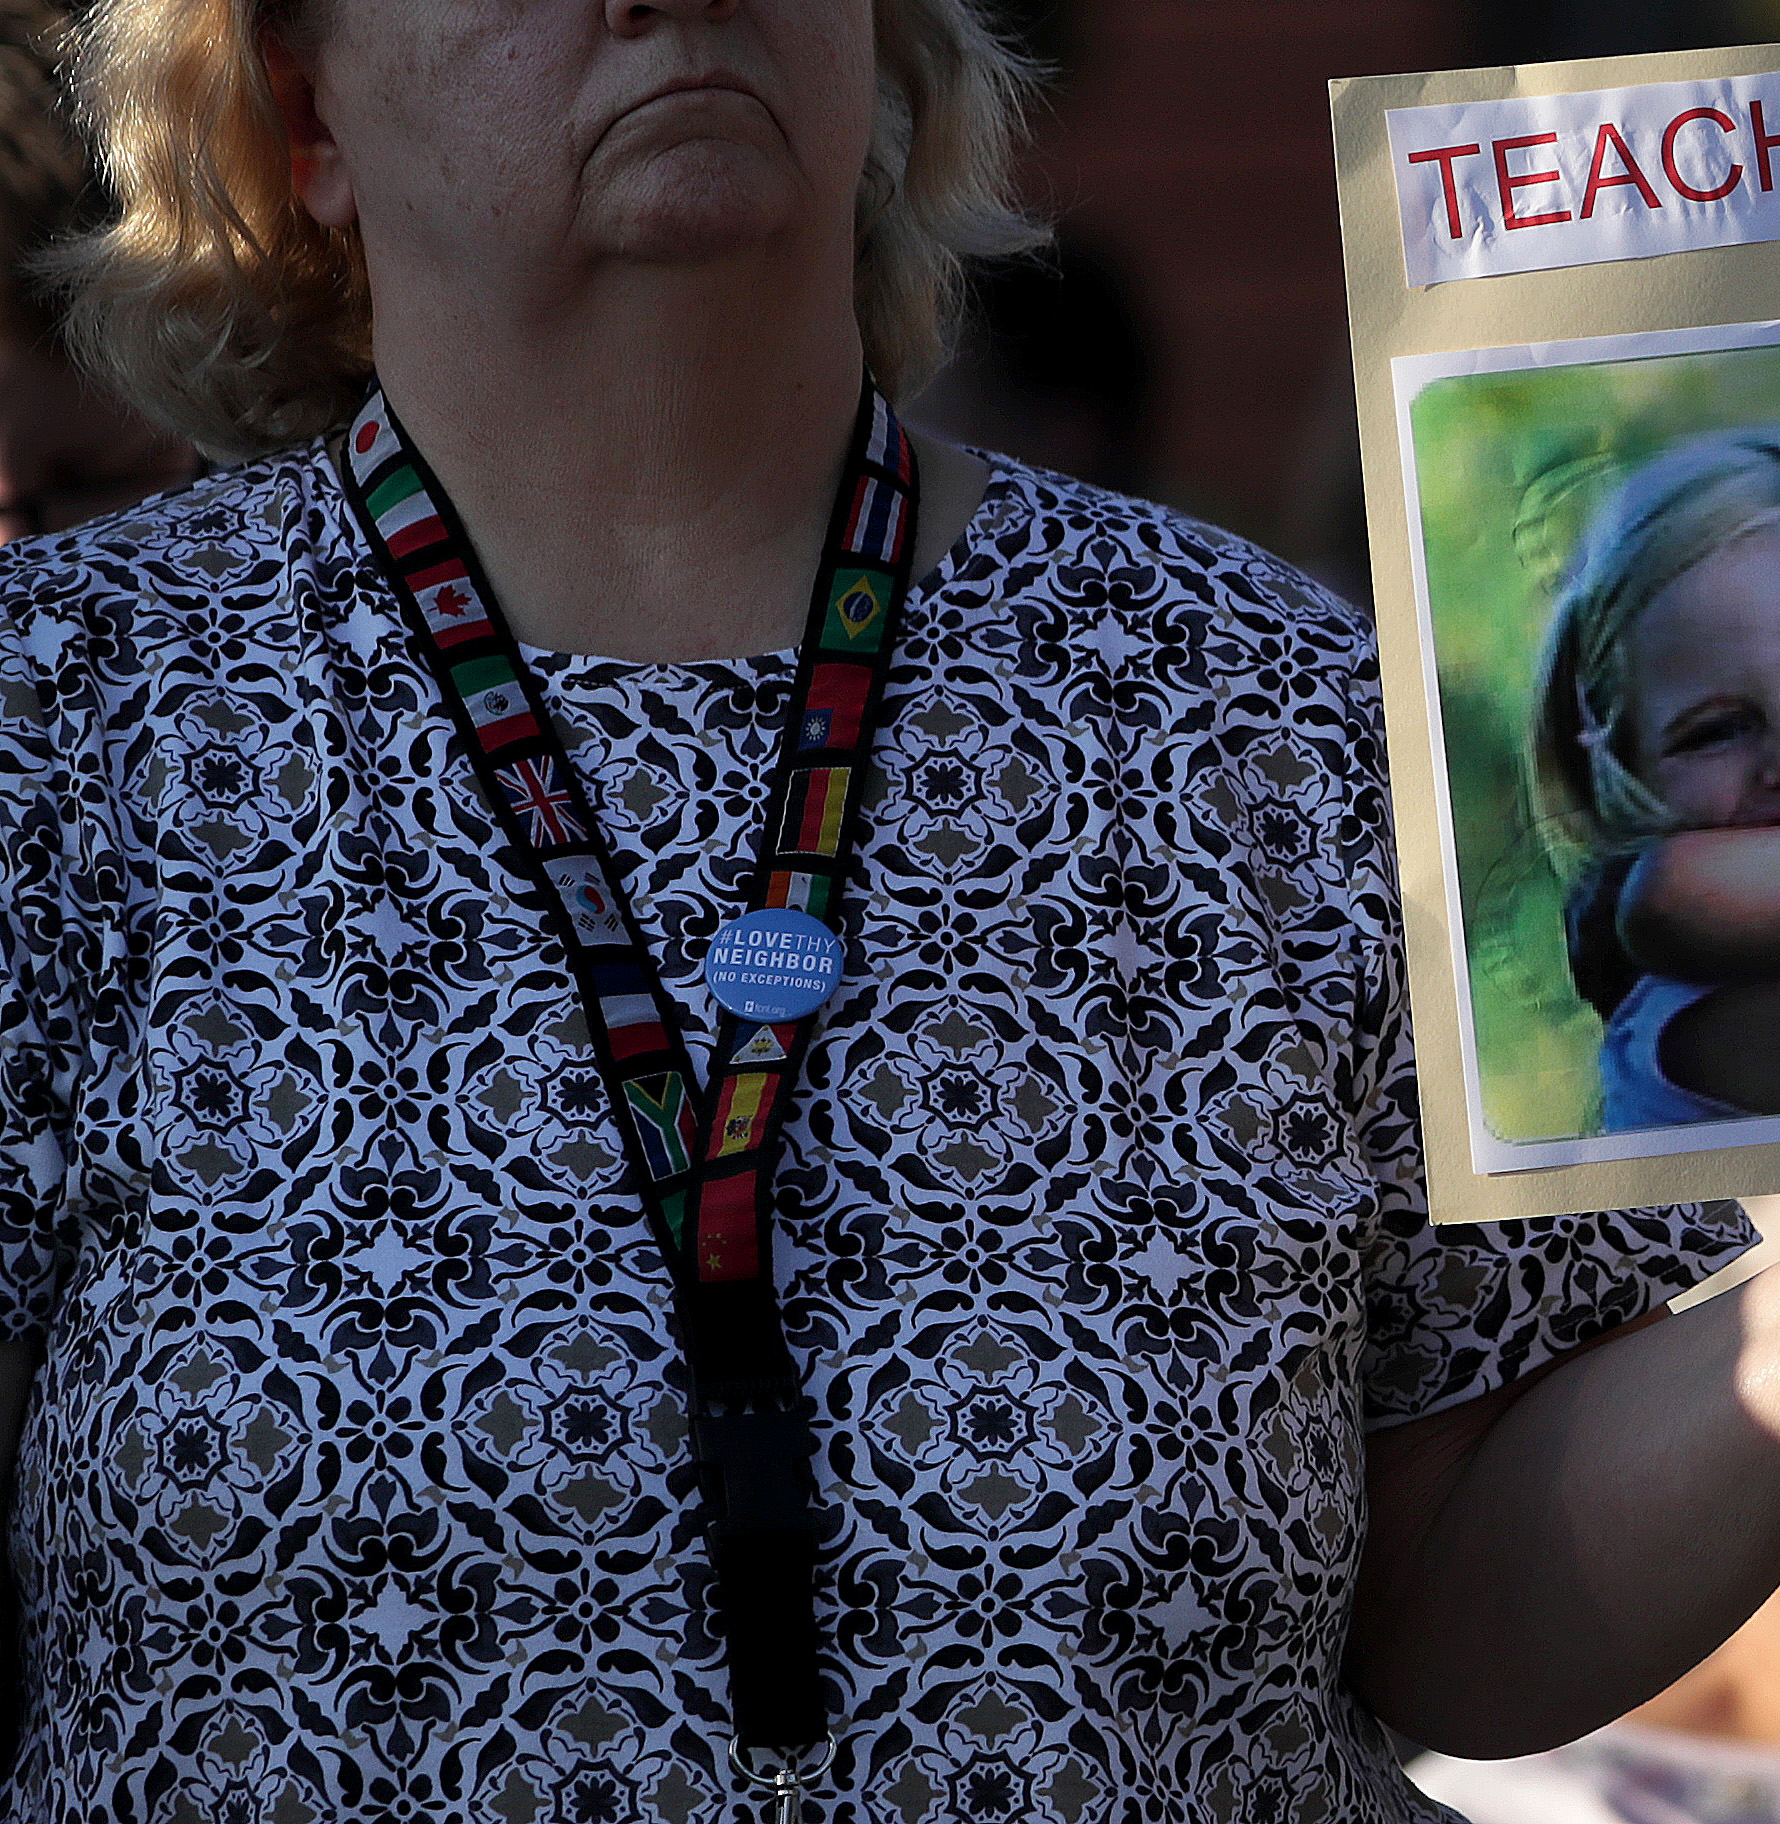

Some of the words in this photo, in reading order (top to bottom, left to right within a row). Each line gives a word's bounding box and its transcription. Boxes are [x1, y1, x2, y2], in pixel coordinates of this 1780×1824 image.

[713, 947, 833, 974] NEIGHBOR
[713, 971, 736, 983] (NO
[740, 972, 826, 992] EXCEPTIONS)
